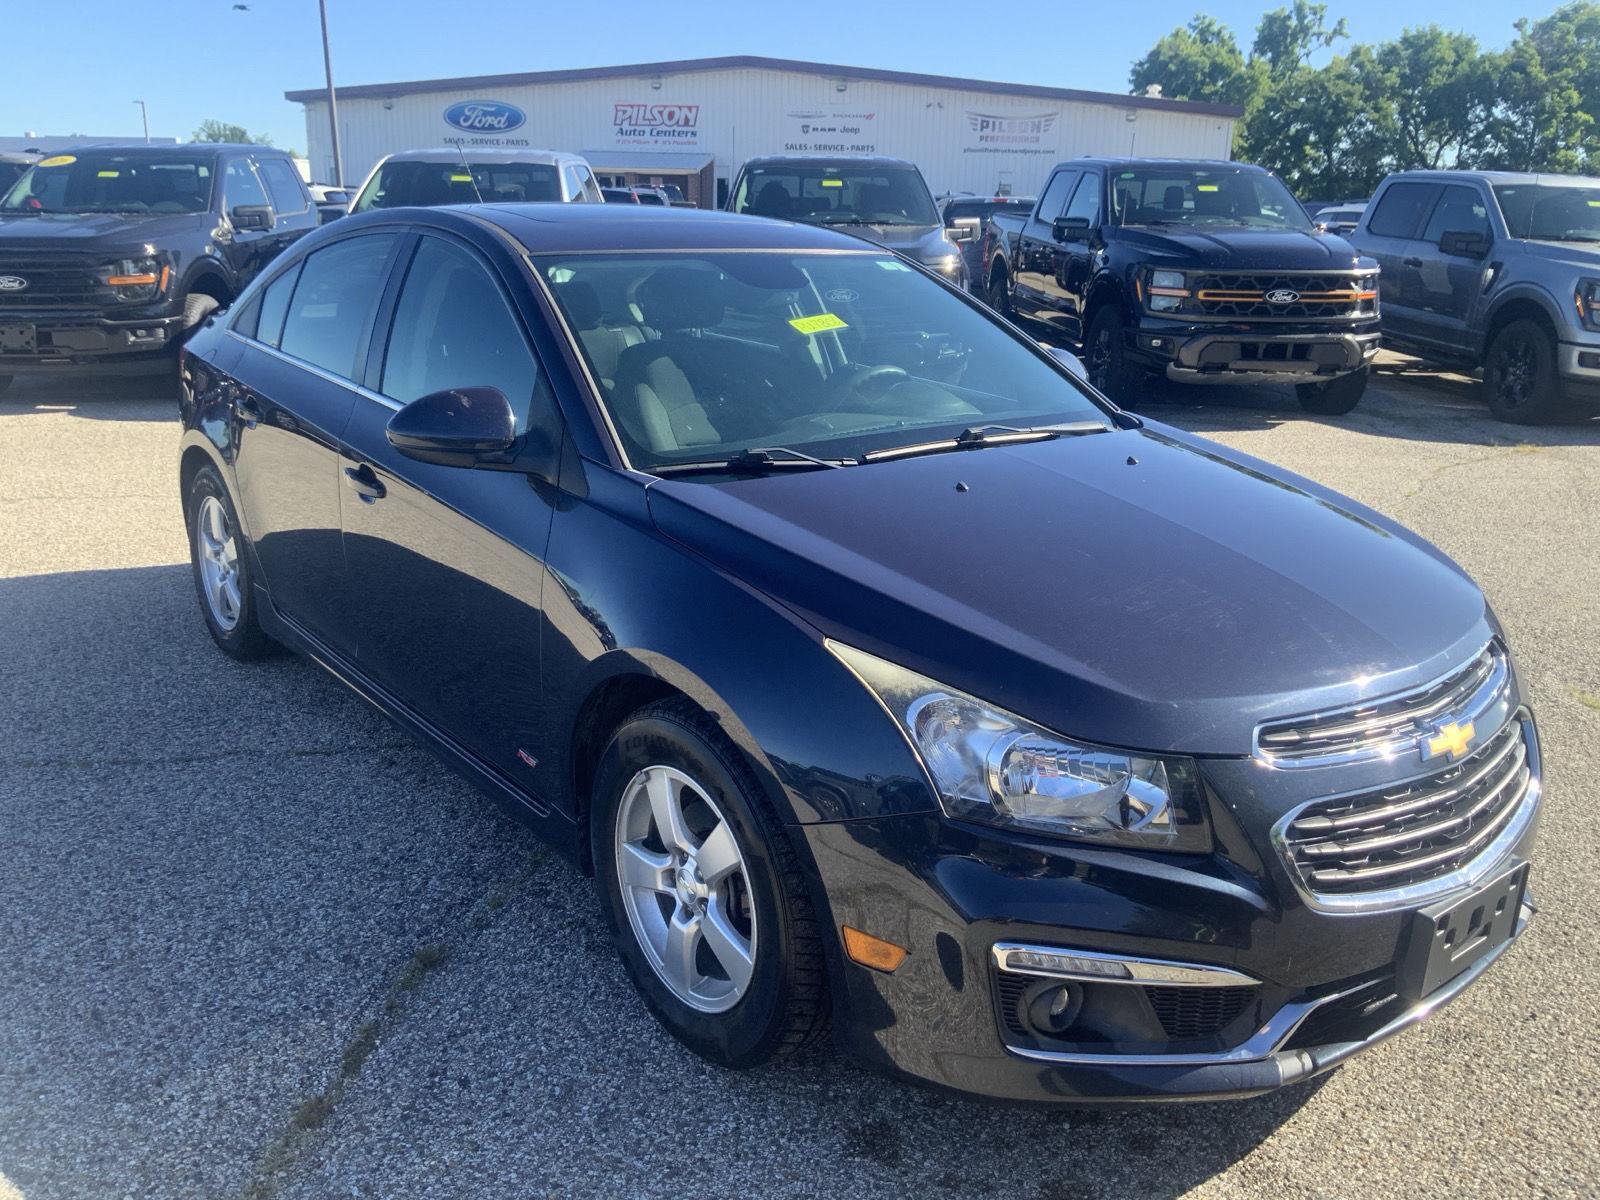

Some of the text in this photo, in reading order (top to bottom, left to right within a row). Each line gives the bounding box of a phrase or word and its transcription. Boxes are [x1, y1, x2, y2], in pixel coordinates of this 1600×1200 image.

[460, 104, 509, 129] Ford
[613, 104, 699, 127] PILSON
[839, 125, 861, 135] Jeep
[980, 119, 1042, 133] PILSON
[616, 127, 698, 138] Auto Centers
[443, 137, 530, 147] SALES SERVICE PARTS
[784, 143, 876, 153] SALES SERVICE PARTS
